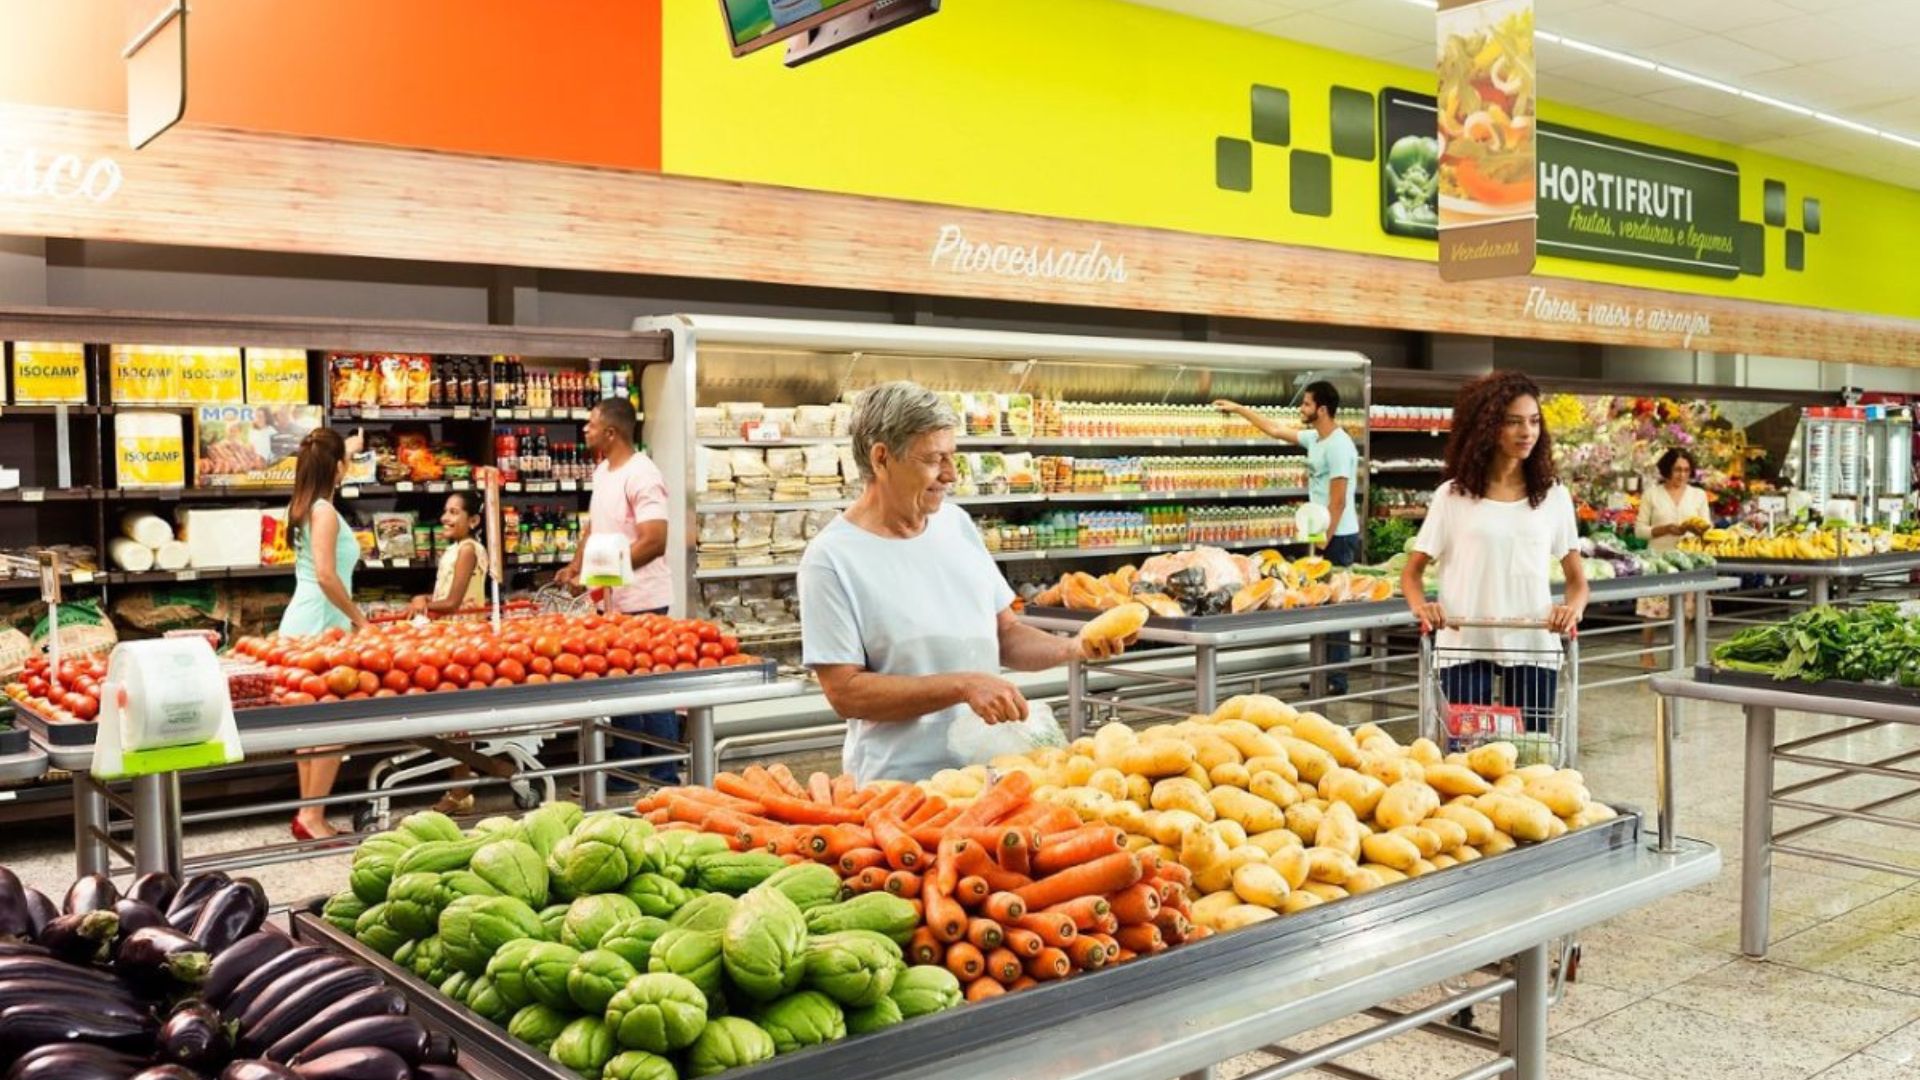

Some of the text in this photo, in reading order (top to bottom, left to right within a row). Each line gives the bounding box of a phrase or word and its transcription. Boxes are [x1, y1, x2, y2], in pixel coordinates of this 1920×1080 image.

[0, 149, 122, 202] sco
[1539, 162, 1692, 222] HORTIFRUTI
[1619, 219, 1675, 246] verduras
[1677, 231, 1686, 246] e
[1687, 226, 1734, 259] legumes
[931, 224, 1128, 283] Processados
[1450, 239, 1521, 262] Verduras
[1588, 303, 1631, 327] vasos
[1635, 311, 1645, 328] e
[1648, 308, 1710, 348] arranjos
[19, 366, 80, 377] ISOCAMP
[117, 367, 173, 379] ISOCAMP
[182, 368, 236, 380] ISOCAMP
[255, 372, 305, 382] ISOCAMP
[202, 407, 255, 421] MOR
[124, 452, 181, 462] ISOCAMP
